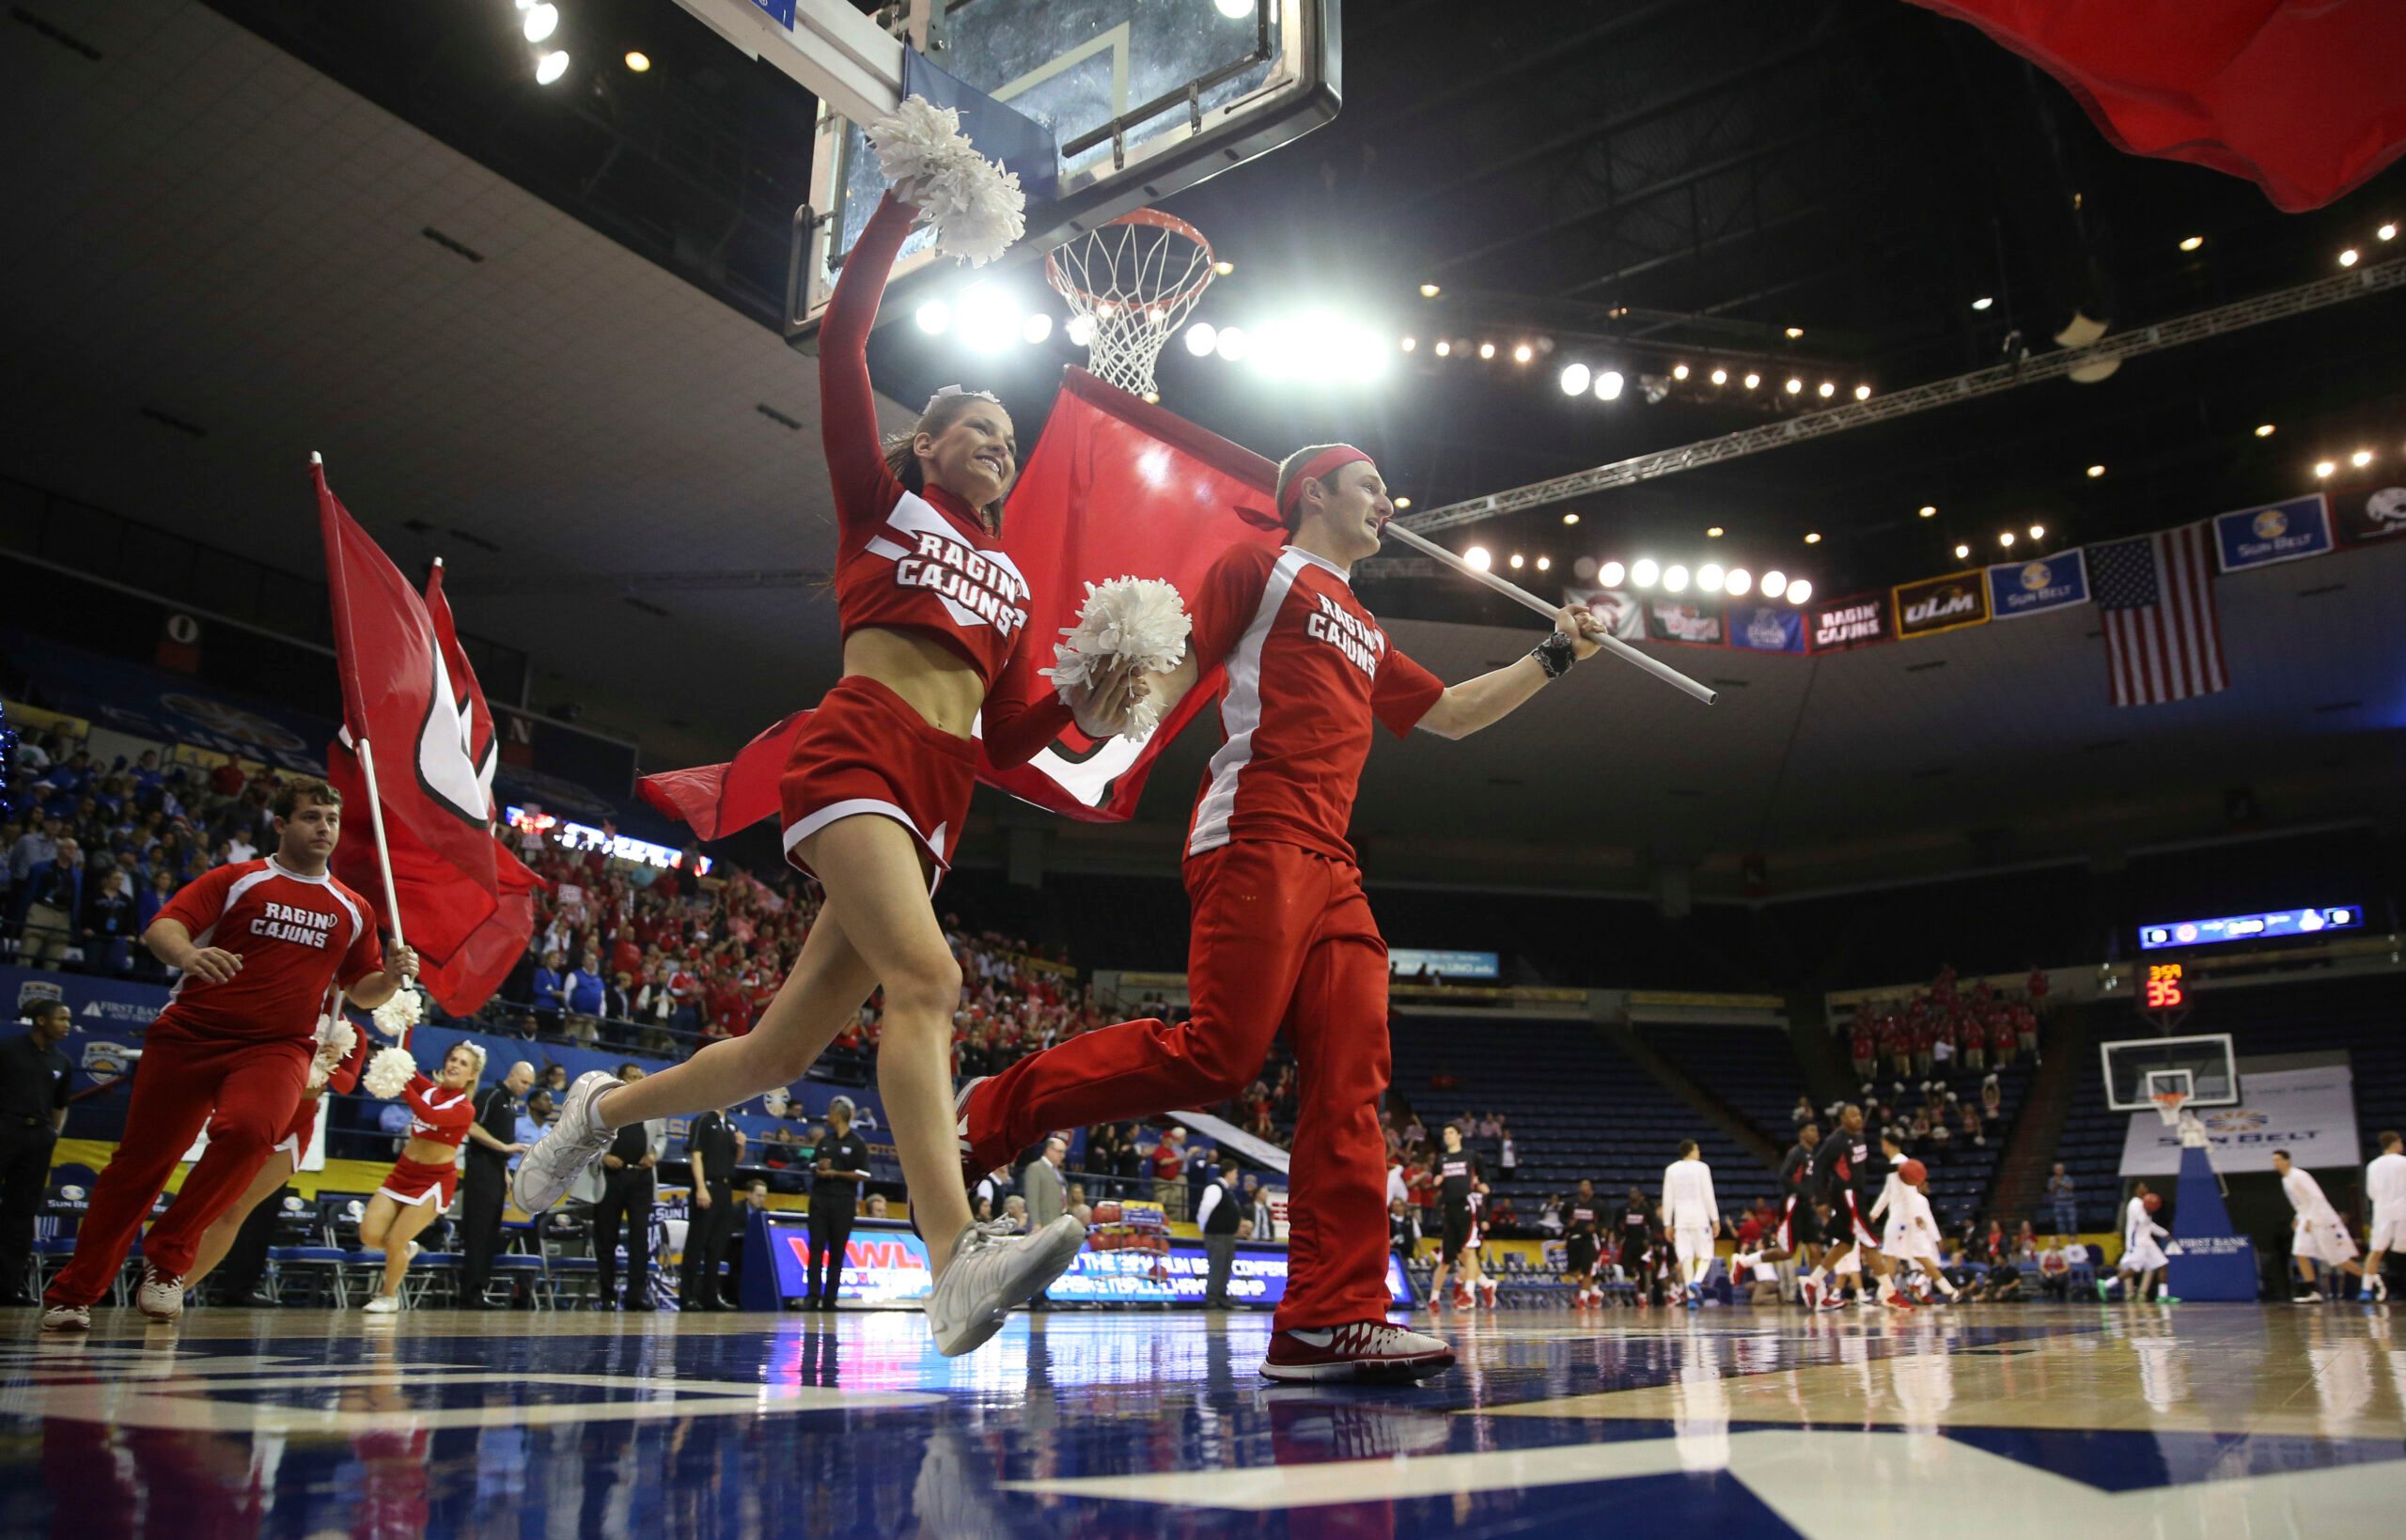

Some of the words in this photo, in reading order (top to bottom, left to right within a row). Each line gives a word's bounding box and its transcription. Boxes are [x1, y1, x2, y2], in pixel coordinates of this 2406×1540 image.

[897, 559, 1016, 638] CAJUNS
[1816, 617, 1881, 646] CAJUNS
[1307, 613, 1376, 682] CAJUNS
[250, 919, 329, 949] CAJUNS
[2147, 978, 2182, 1007] 35
[2239, 1128, 2320, 1143] BELT
[47, 1199, 71, 1208] SUN
[655, 1207, 682, 1221] SUN
[2179, 1237, 2211, 1248] FIRST
[2213, 1237, 2248, 1247] BANK
